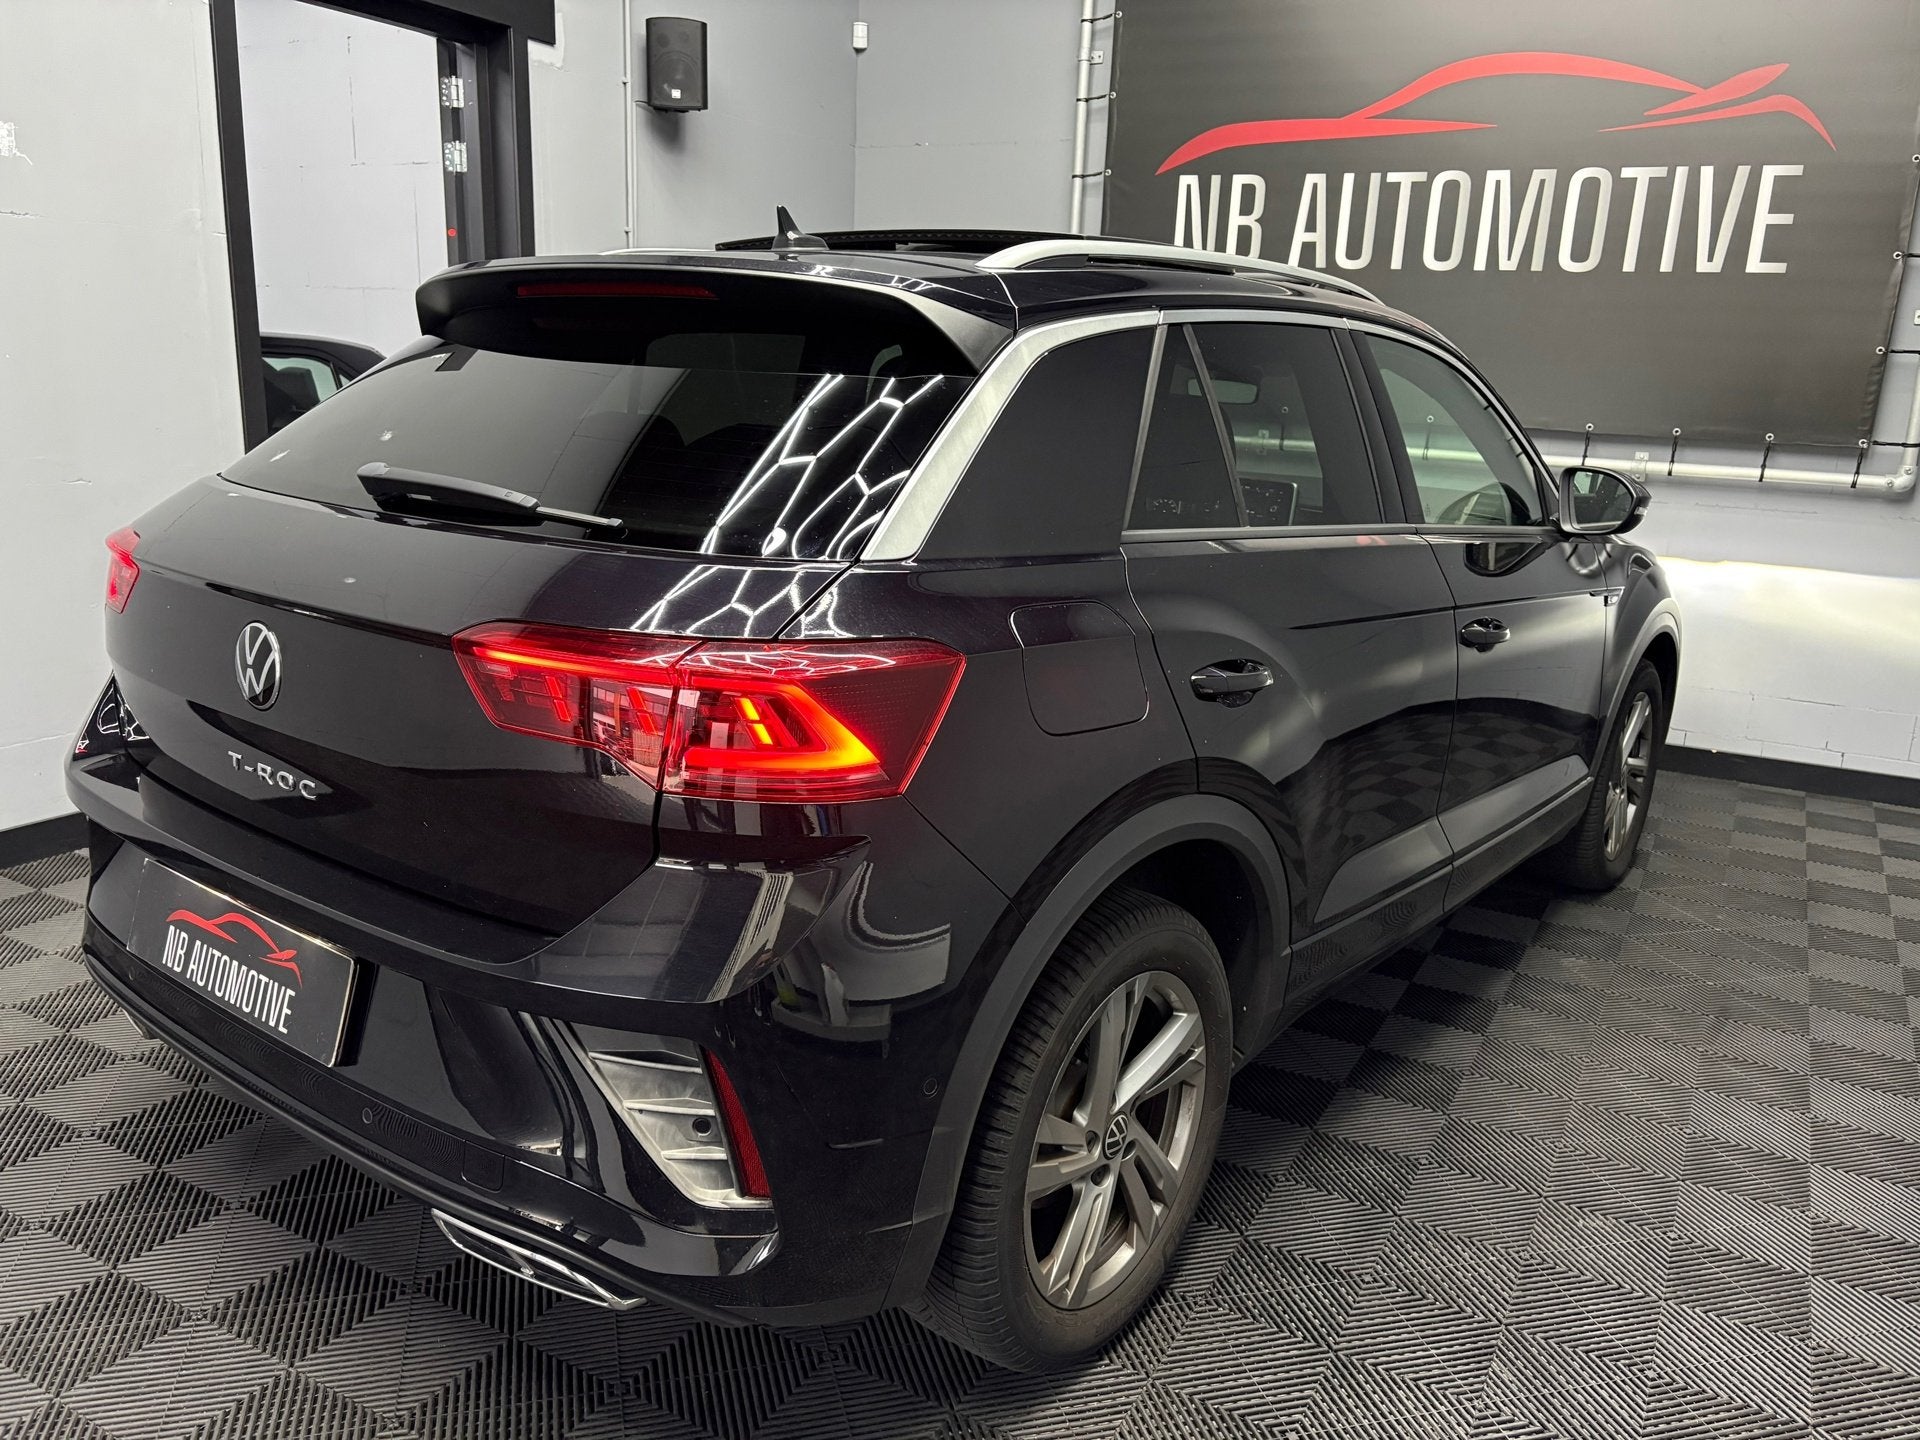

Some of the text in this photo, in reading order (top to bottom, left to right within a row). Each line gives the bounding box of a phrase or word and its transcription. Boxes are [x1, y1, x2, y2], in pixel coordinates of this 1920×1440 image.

[1173, 164, 1804, 274] NB AUTOMOTIVE
[228, 751, 317, 800] T-ROC
[163, 925, 295, 1034] NB AUTOMOTIVE
